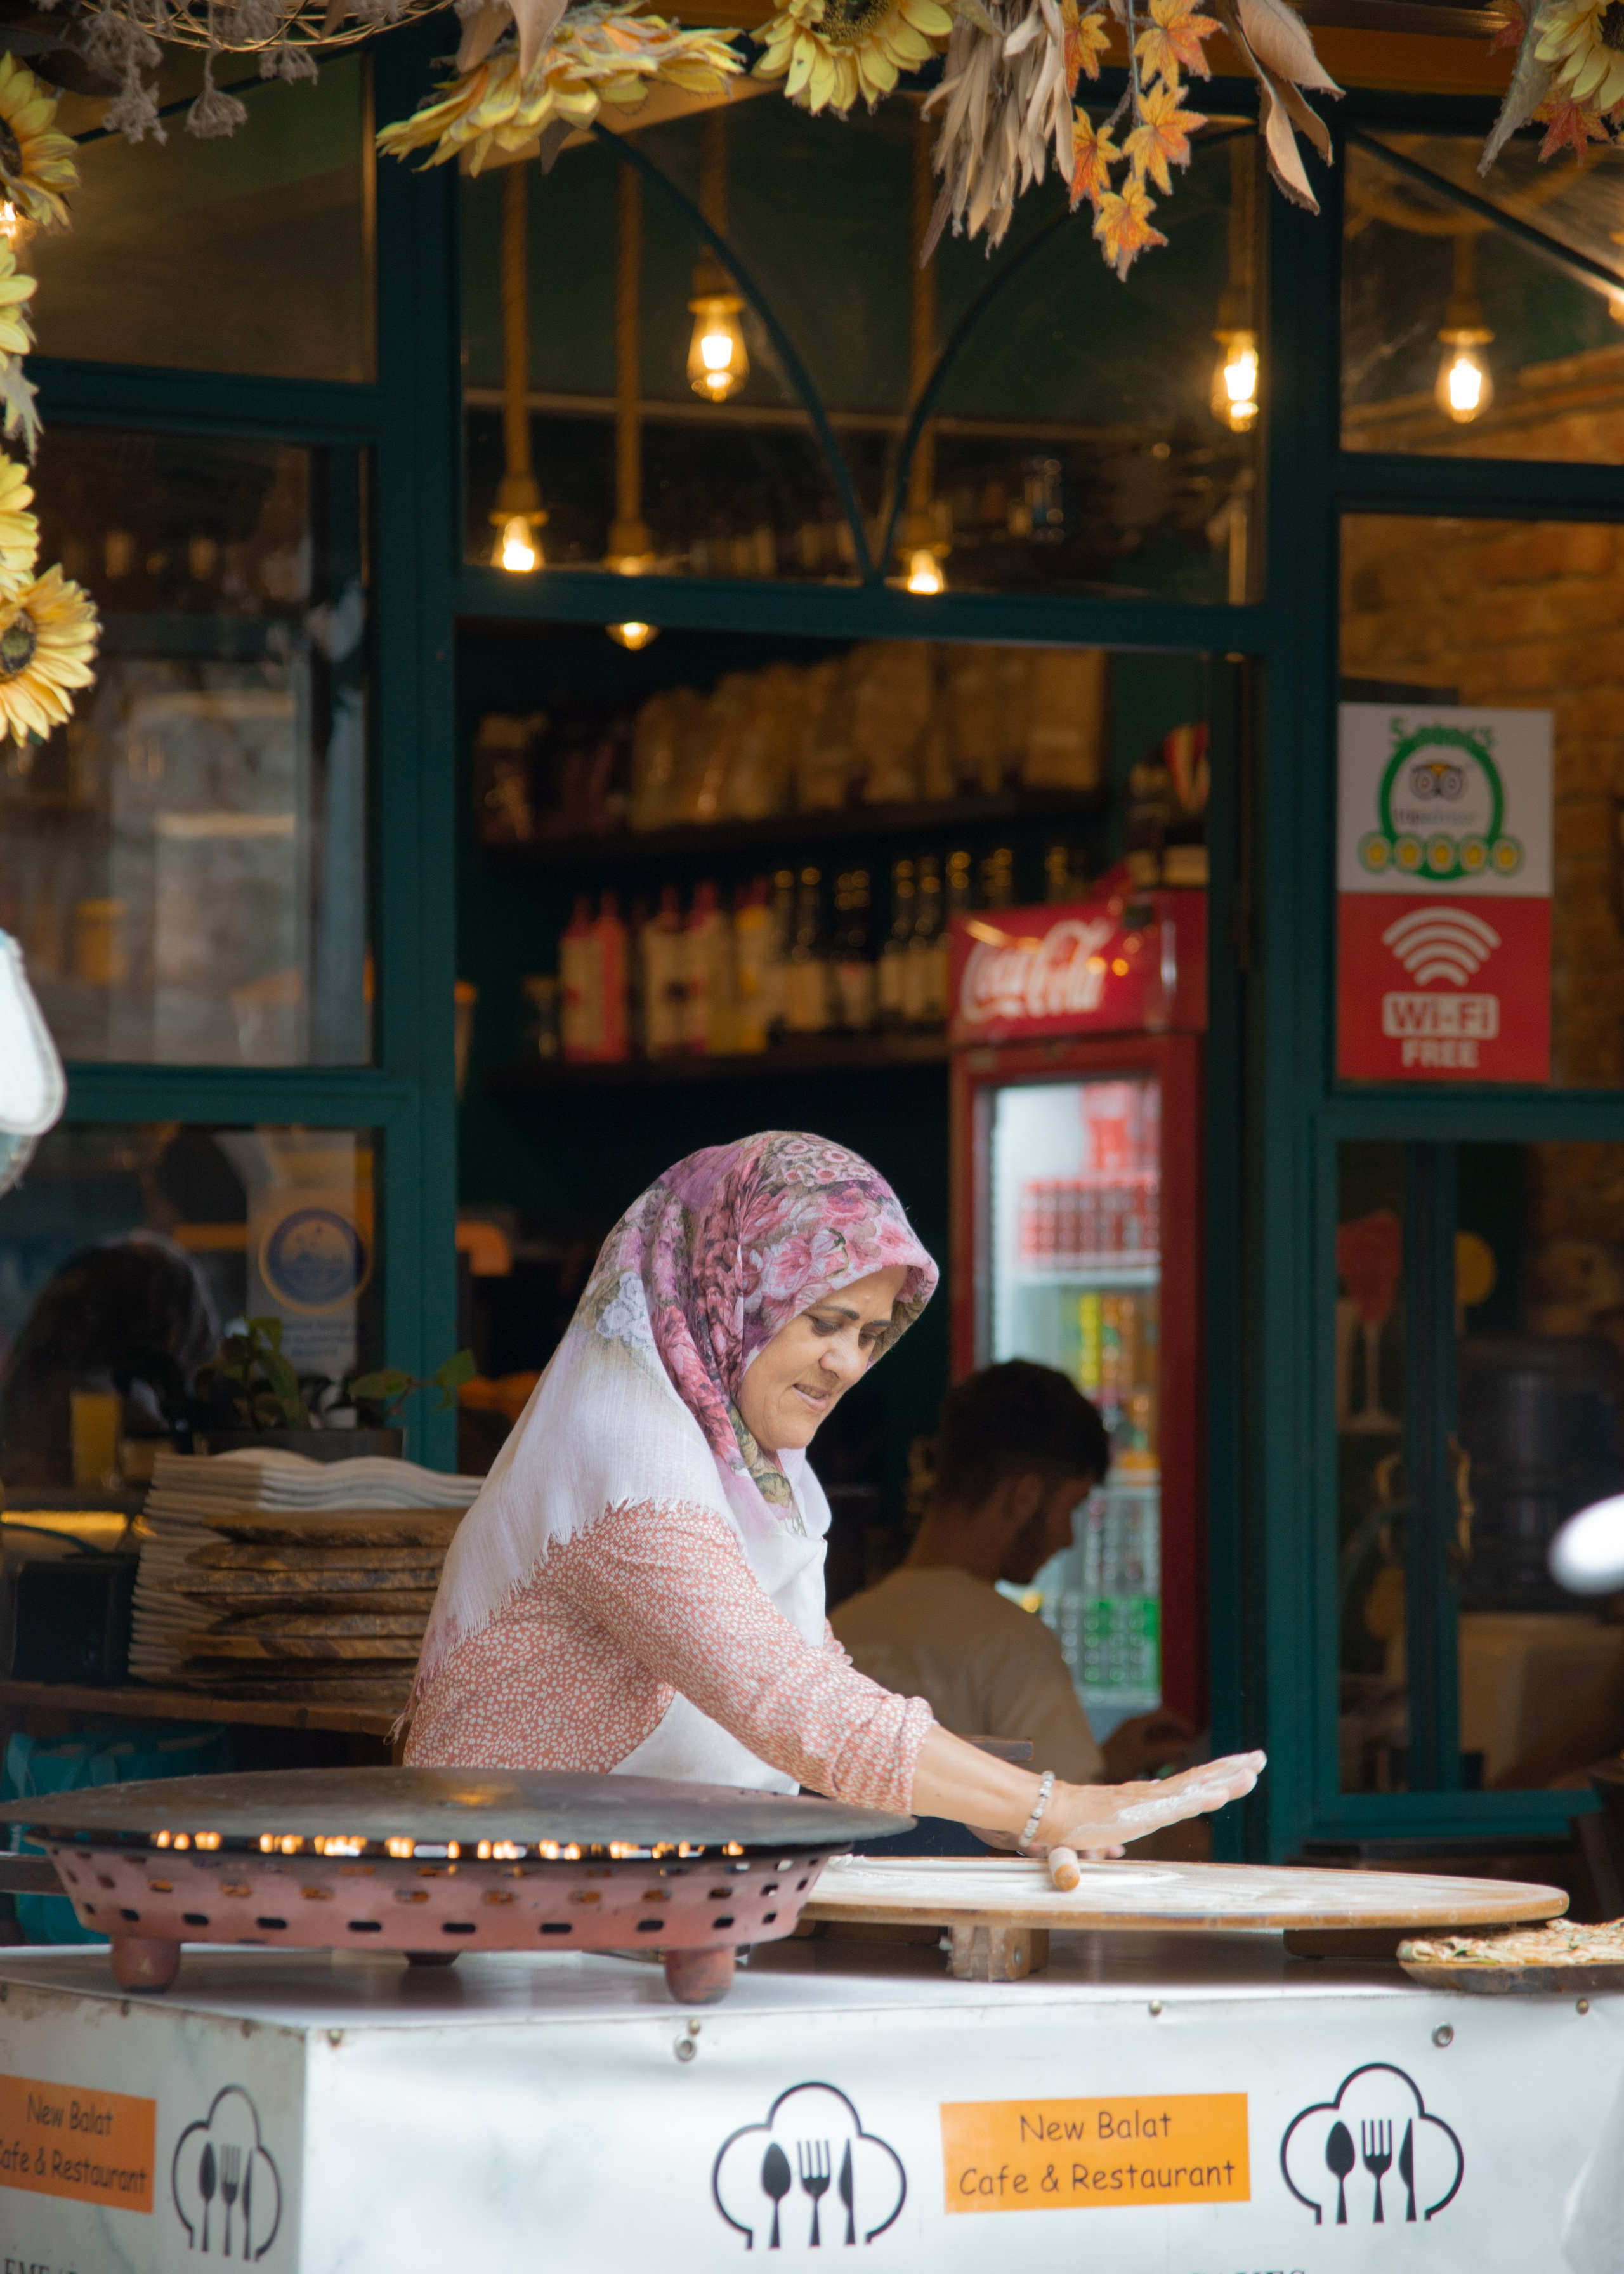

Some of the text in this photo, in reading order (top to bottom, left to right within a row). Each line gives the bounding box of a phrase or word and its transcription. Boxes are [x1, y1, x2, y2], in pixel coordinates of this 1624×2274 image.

[1402, 1039, 1479, 1068] FREE
[27, 2093, 113, 2136] New Balat
[1019, 2110, 1172, 2143] New Balat
[0, 2139, 147, 2194] afe & Restaurant
[959, 2160, 1236, 2197] Cafe & Restaurant
